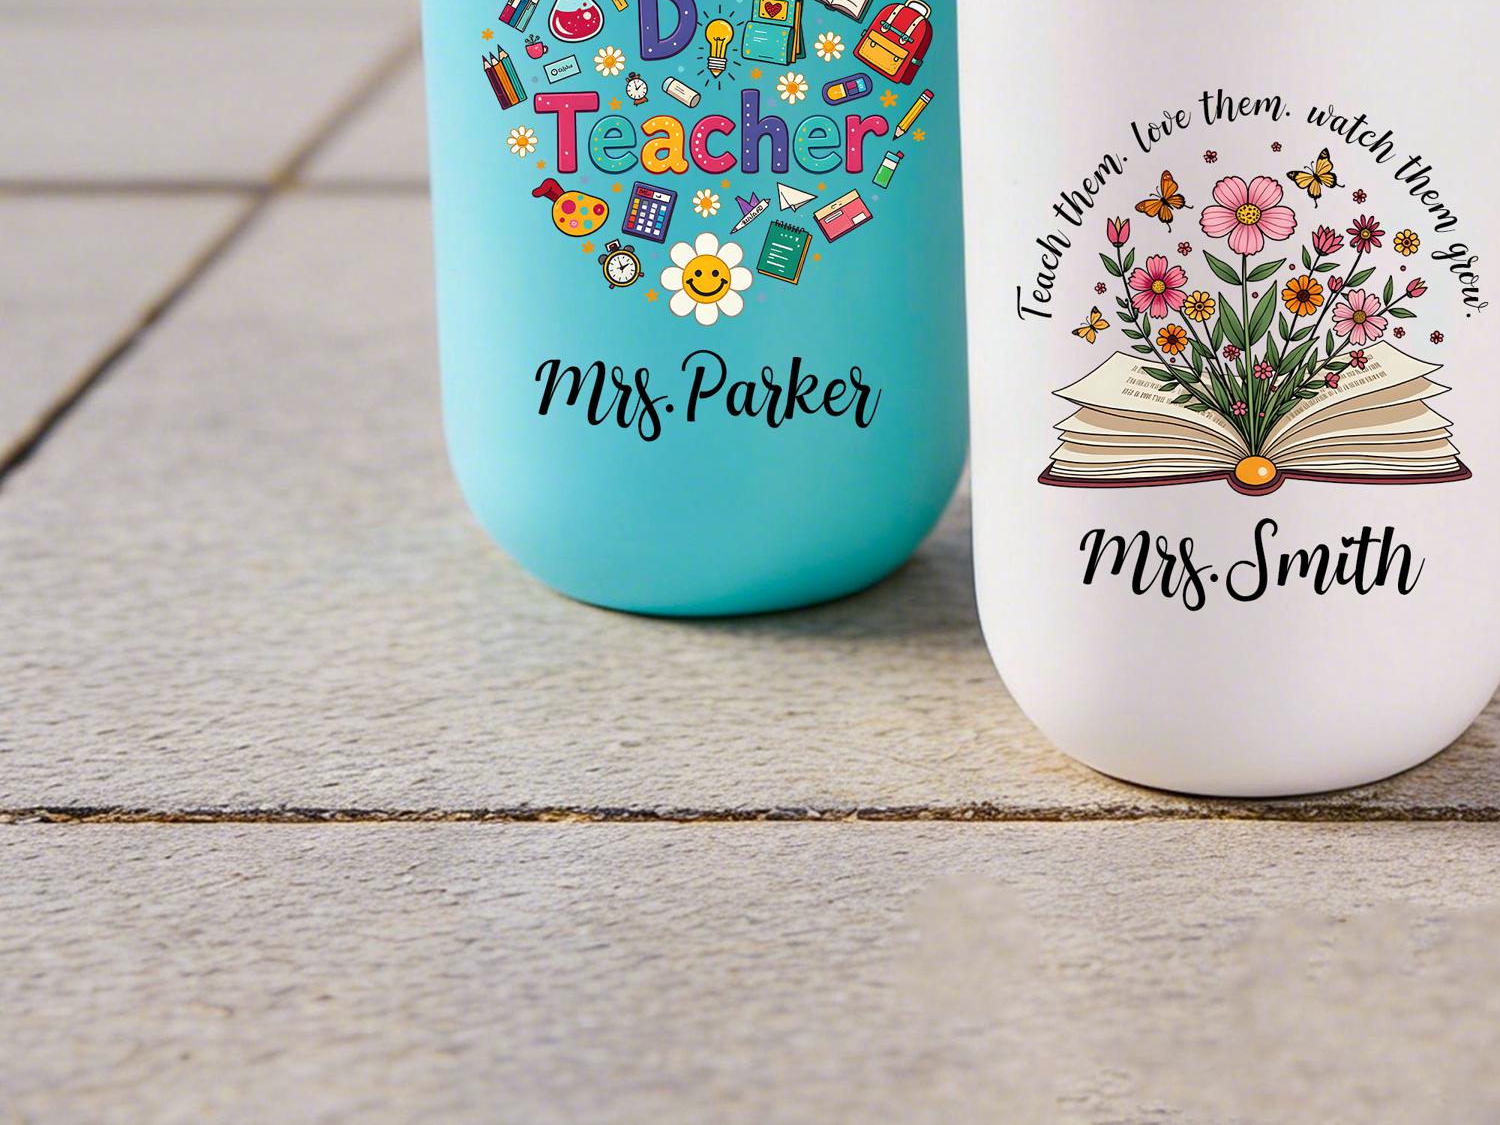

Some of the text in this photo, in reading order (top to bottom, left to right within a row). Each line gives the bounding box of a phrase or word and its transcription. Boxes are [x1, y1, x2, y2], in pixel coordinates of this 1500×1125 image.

[533, 88, 890, 175] Teacher
[1016, 228, 1073, 322] Teach
[1130, 108, 1192, 154] love
[1306, 104, 1396, 165] watch
[1393, 153, 1461, 234] them
